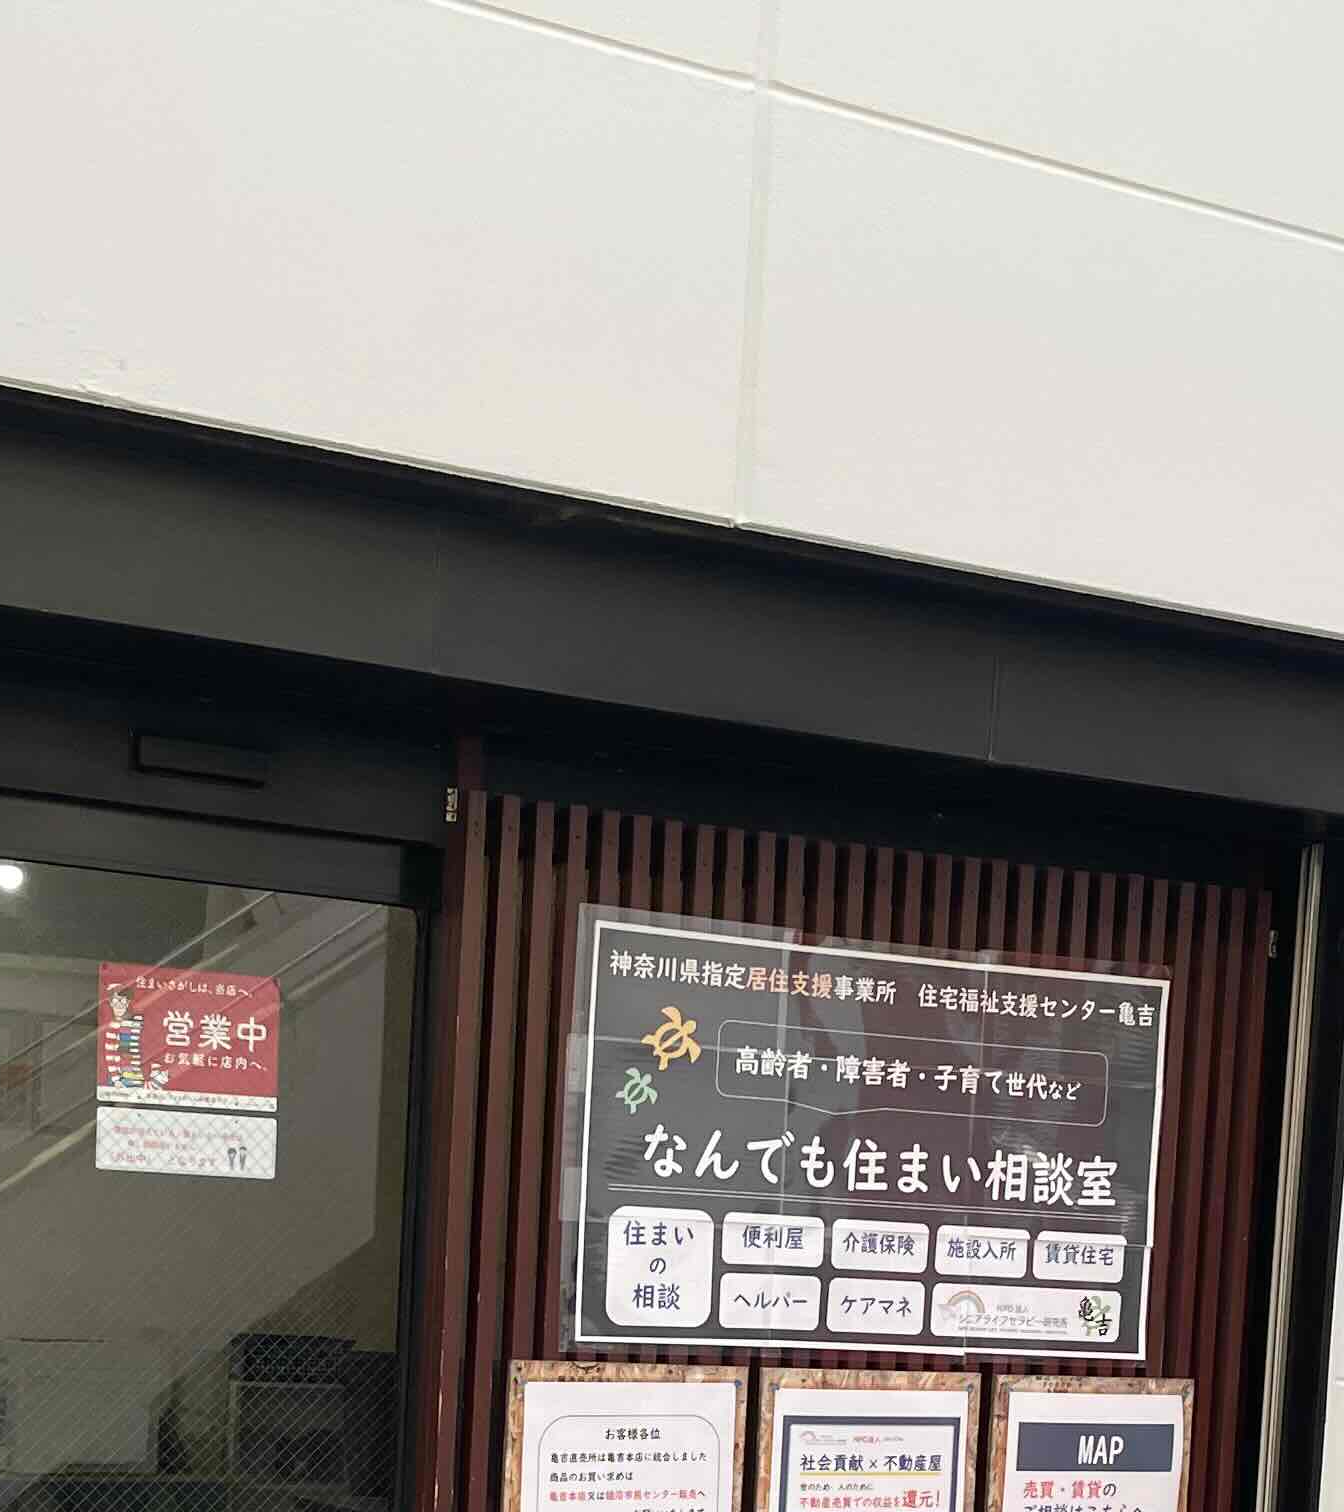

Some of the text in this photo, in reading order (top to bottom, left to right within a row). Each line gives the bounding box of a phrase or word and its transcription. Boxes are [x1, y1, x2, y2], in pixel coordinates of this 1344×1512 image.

[609, 949, 1155, 1027] 神奈川県指定居住支援事業所 住宅福祉支援センター亀吉
[162, 1009, 268, 1053] 営業中
[735, 1046, 1082, 1101] 高齢者・障害者・子育て世代など
[643, 1123, 1119, 1208] なんでも住まい相談室
[623, 1220, 695, 1246] 住まい
[742, 1224, 805, 1250] 便利屋
[842, 1231, 916, 1257] 介護保険
[946, 1238, 1017, 1262] 施設入所
[1045, 1242, 1115, 1267] 賃貸住宅
[649, 1257, 667, 1275] の
[632, 1283, 681, 1311] 相談
[733, 1291, 807, 1310] ヘルパー
[839, 1295, 913, 1316] ケアマネ
[605, 1428, 661, 1441] お客様各位
[1077, 1434, 1124, 1465] MAP
[799, 1453, 865, 1473] 社会貢献
[883, 1453, 944, 1473] 不動産屋
[1023, 1479, 1117, 1499] 売買・賃貸の
